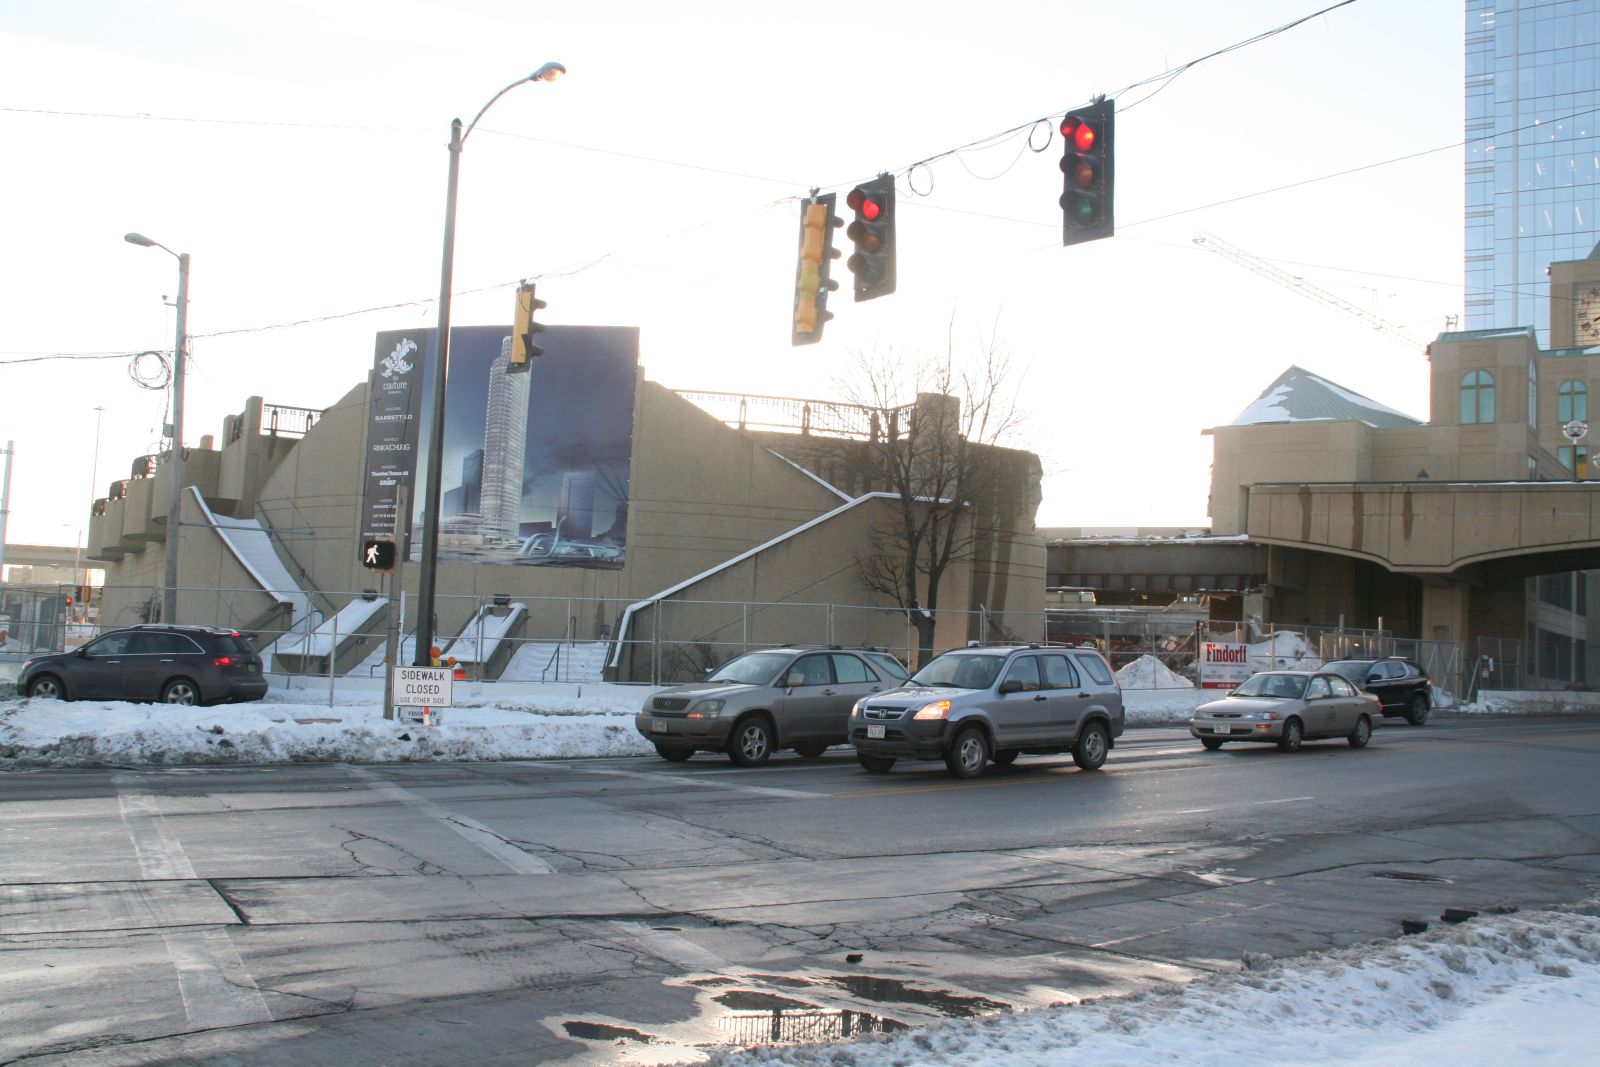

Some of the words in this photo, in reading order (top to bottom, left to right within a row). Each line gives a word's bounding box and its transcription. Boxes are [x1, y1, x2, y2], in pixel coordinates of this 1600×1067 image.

[1206, 643, 1247, 663] Findorff
[401, 670, 445, 681] SIDEWALK
[406, 684, 440, 695] CLOSED
[399, 696, 410, 704] USE
